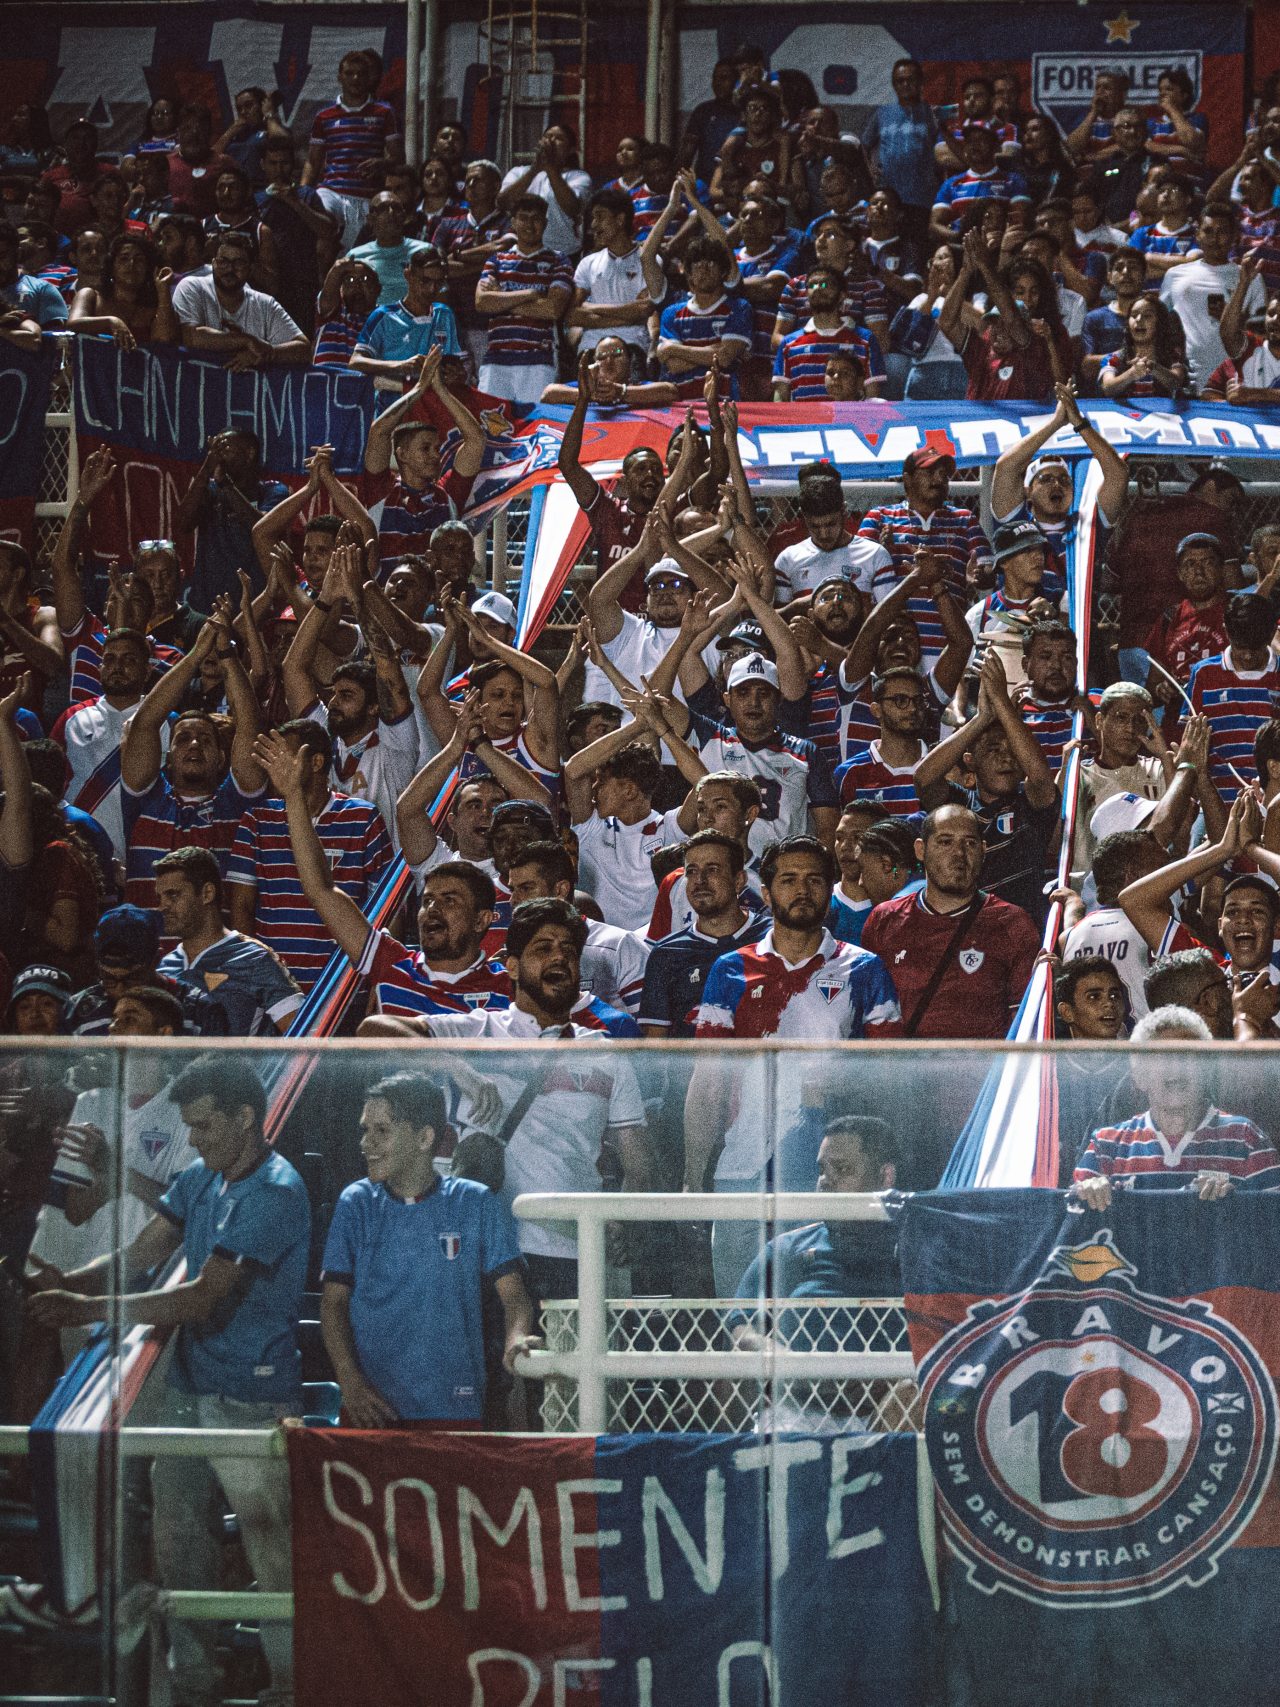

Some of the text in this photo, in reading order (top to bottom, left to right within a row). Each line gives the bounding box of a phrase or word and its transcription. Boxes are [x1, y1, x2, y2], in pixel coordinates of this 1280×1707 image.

[1042, 62, 1192, 93] FORTLEZA
[80, 334, 366, 474] CANTAMOS
[947, 1305, 1227, 1389] BRAVO
[942, 1422, 1235, 1569] SEM DEMONSTRAR CANSAÇO
[1009, 1366, 1169, 1504] 18
[322, 1434, 886, 1613] SOMENTE
